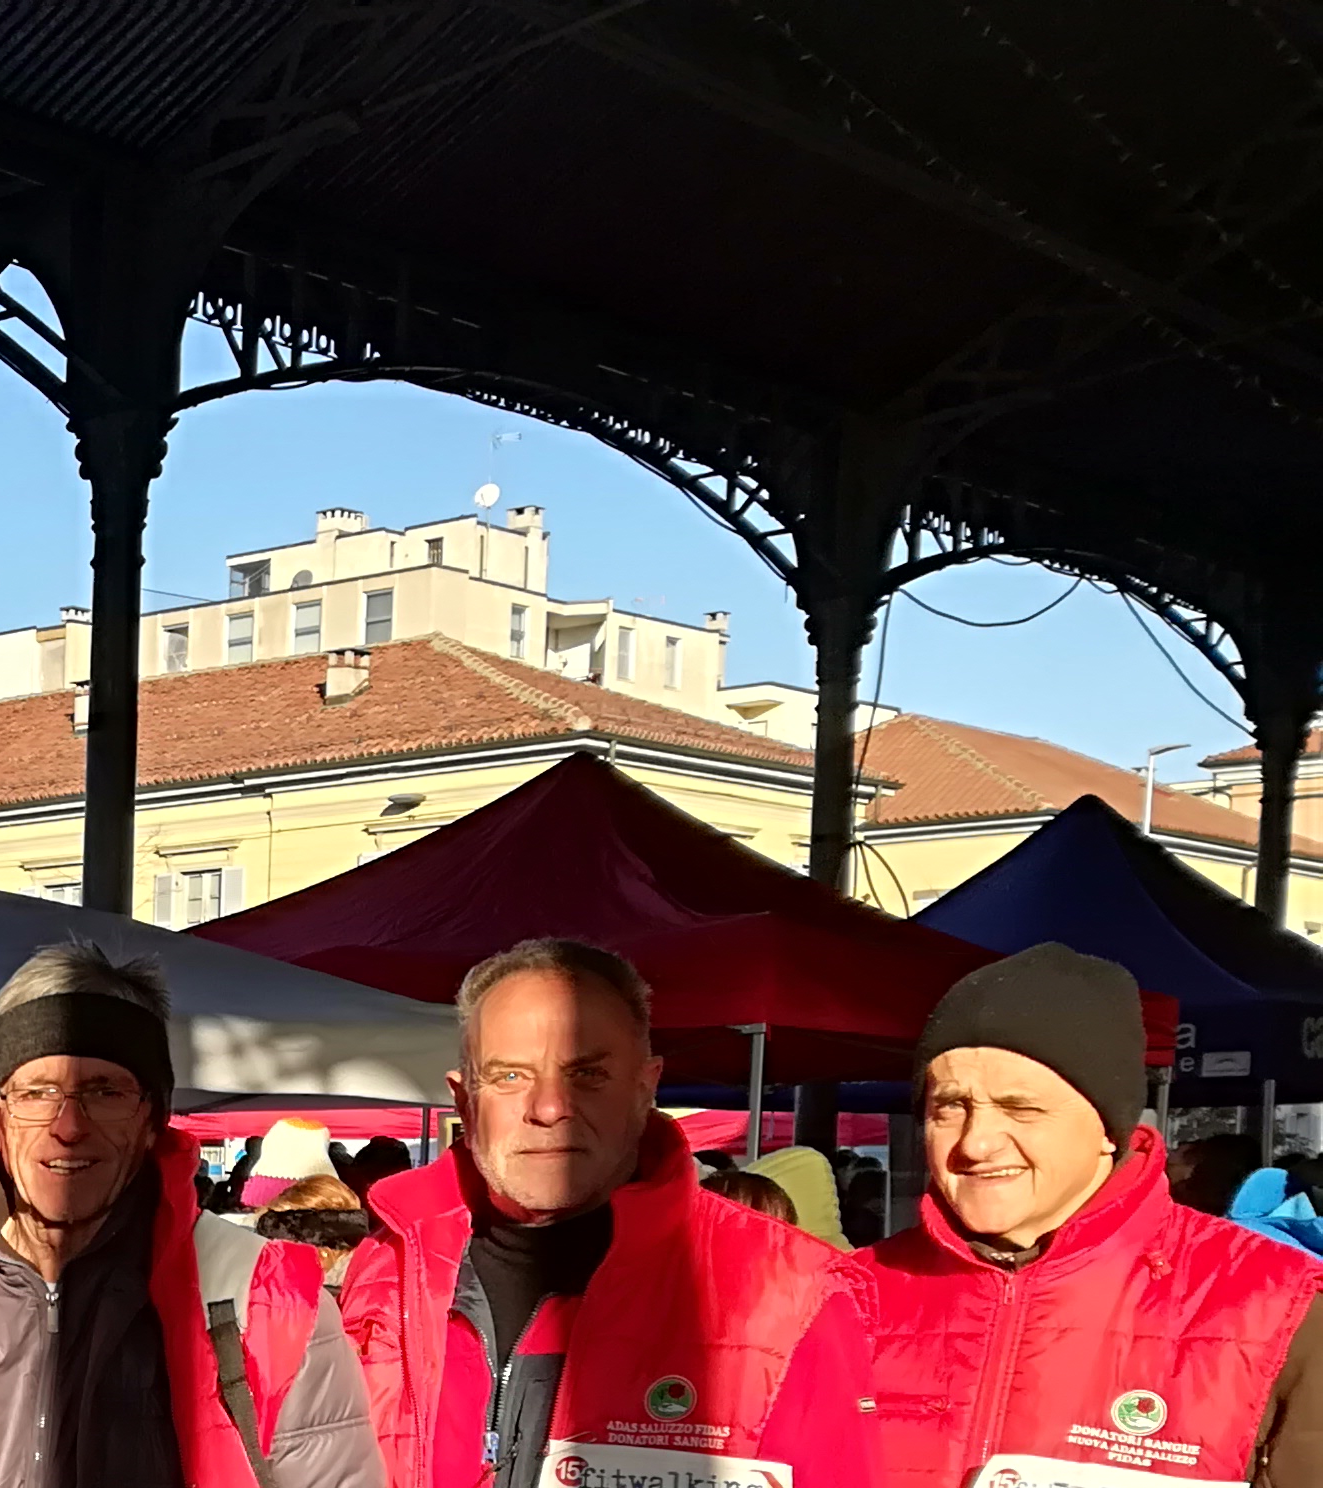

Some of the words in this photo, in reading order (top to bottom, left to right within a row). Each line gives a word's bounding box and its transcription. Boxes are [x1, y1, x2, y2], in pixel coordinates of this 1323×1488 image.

[606, 1420, 639, 1433] ADAS
[640, 1422, 694, 1435] SALUZZO
[695, 1425, 731, 1438] FIDAS
[608, 1432, 670, 1446] DONATORI
[672, 1436, 725, 1450] SANGUE
[1071, 1424, 1143, 1447] DONATORI
[1144, 1438, 1202, 1455] SANGUE
[1067, 1435, 1109, 1450] NUOVA
[1110, 1443, 1144, 1456] ADAS
[1144, 1450, 1198, 1466] SALUZZO
[1107, 1452, 1152, 1467] FIDAS
